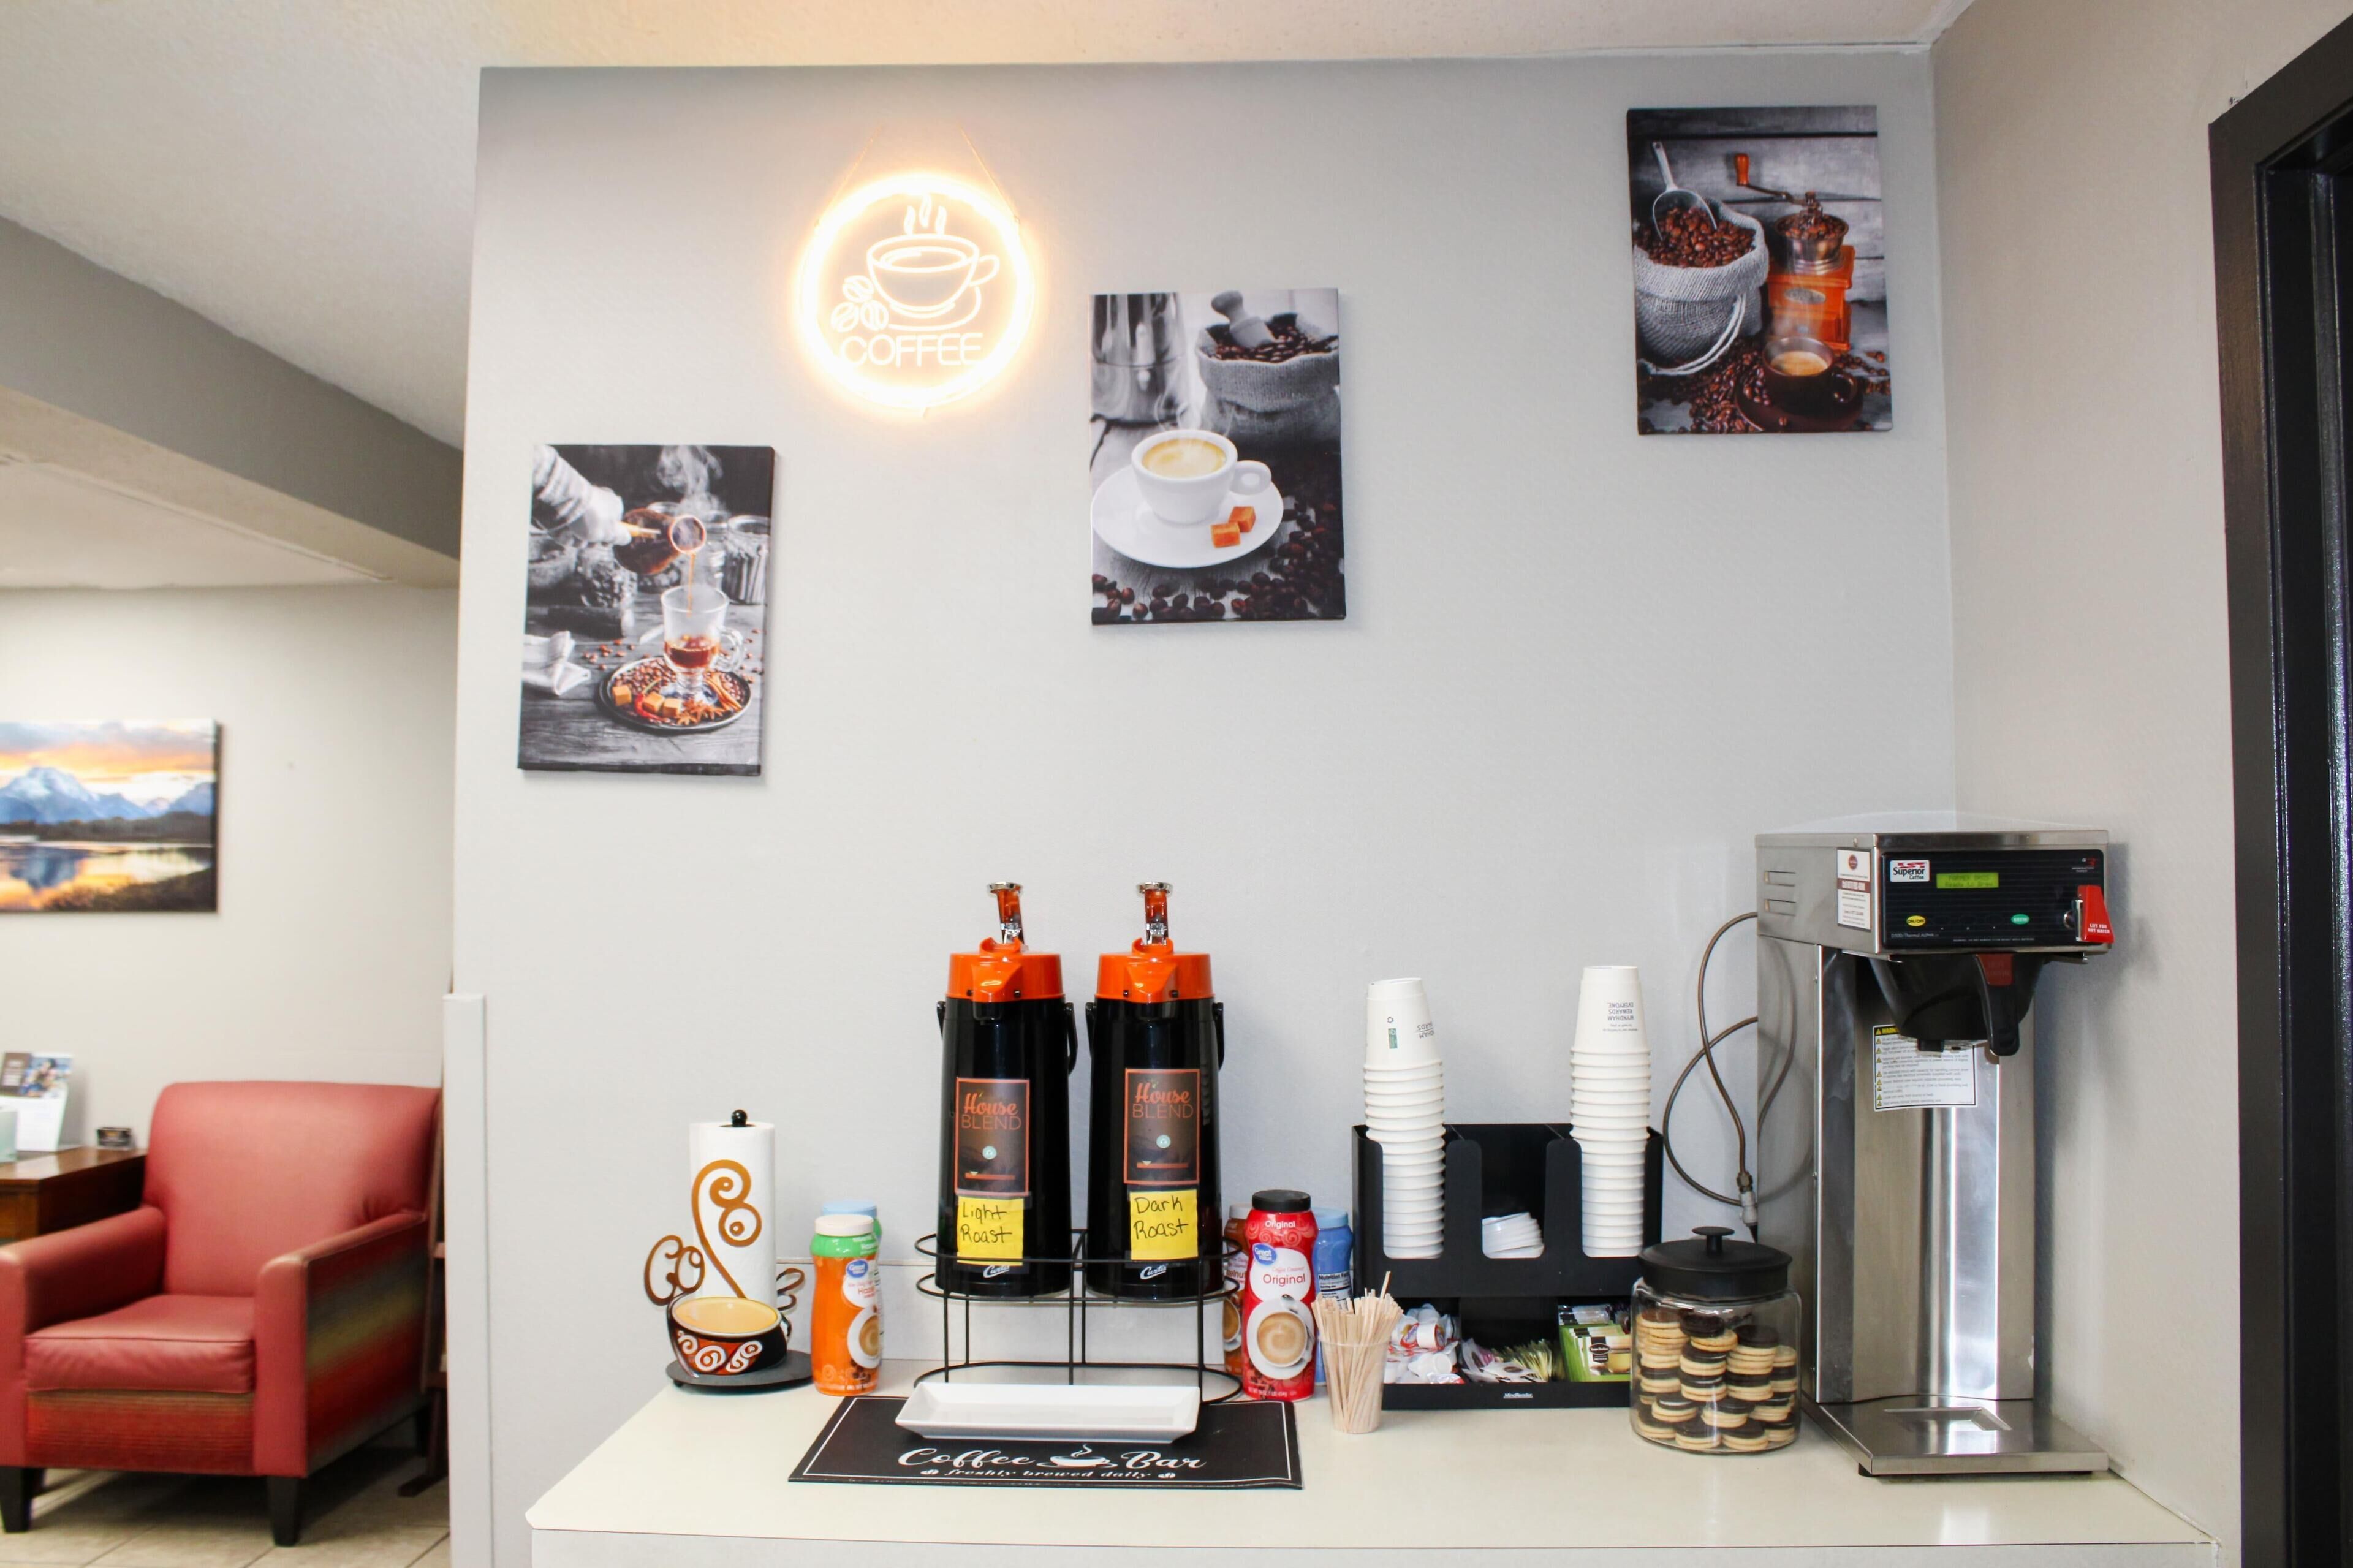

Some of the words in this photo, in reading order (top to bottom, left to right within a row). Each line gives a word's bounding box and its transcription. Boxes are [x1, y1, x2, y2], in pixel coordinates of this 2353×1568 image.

[839, 332, 983, 368] COFFEE
[1893, 867, 1925, 877] Superior
[1135, 1082, 1191, 1104] House
[964, 1093, 1018, 1116] House
[1132, 1103, 1194, 1118] BLEND
[961, 1114, 1022, 1131] BLEND
[962, 1202, 1007, 1225] Light
[1134, 1195, 1183, 1214] Dark
[960, 1224, 1013, 1244] Roast
[1133, 1218, 1189, 1240] Roast
[1265, 1220, 1296, 1230] Original
[1254, 1247, 1272, 1257] Great
[1140, 1263, 1168, 1280] Curtis
[1262, 1273, 1306, 1287] Original
[898, 1447, 1036, 1468] Coffee
[1120, 1450, 1207, 1469] Bar
[944, 1469, 1017, 1477] freshly
[1101, 1471, 1151, 1479] daily
